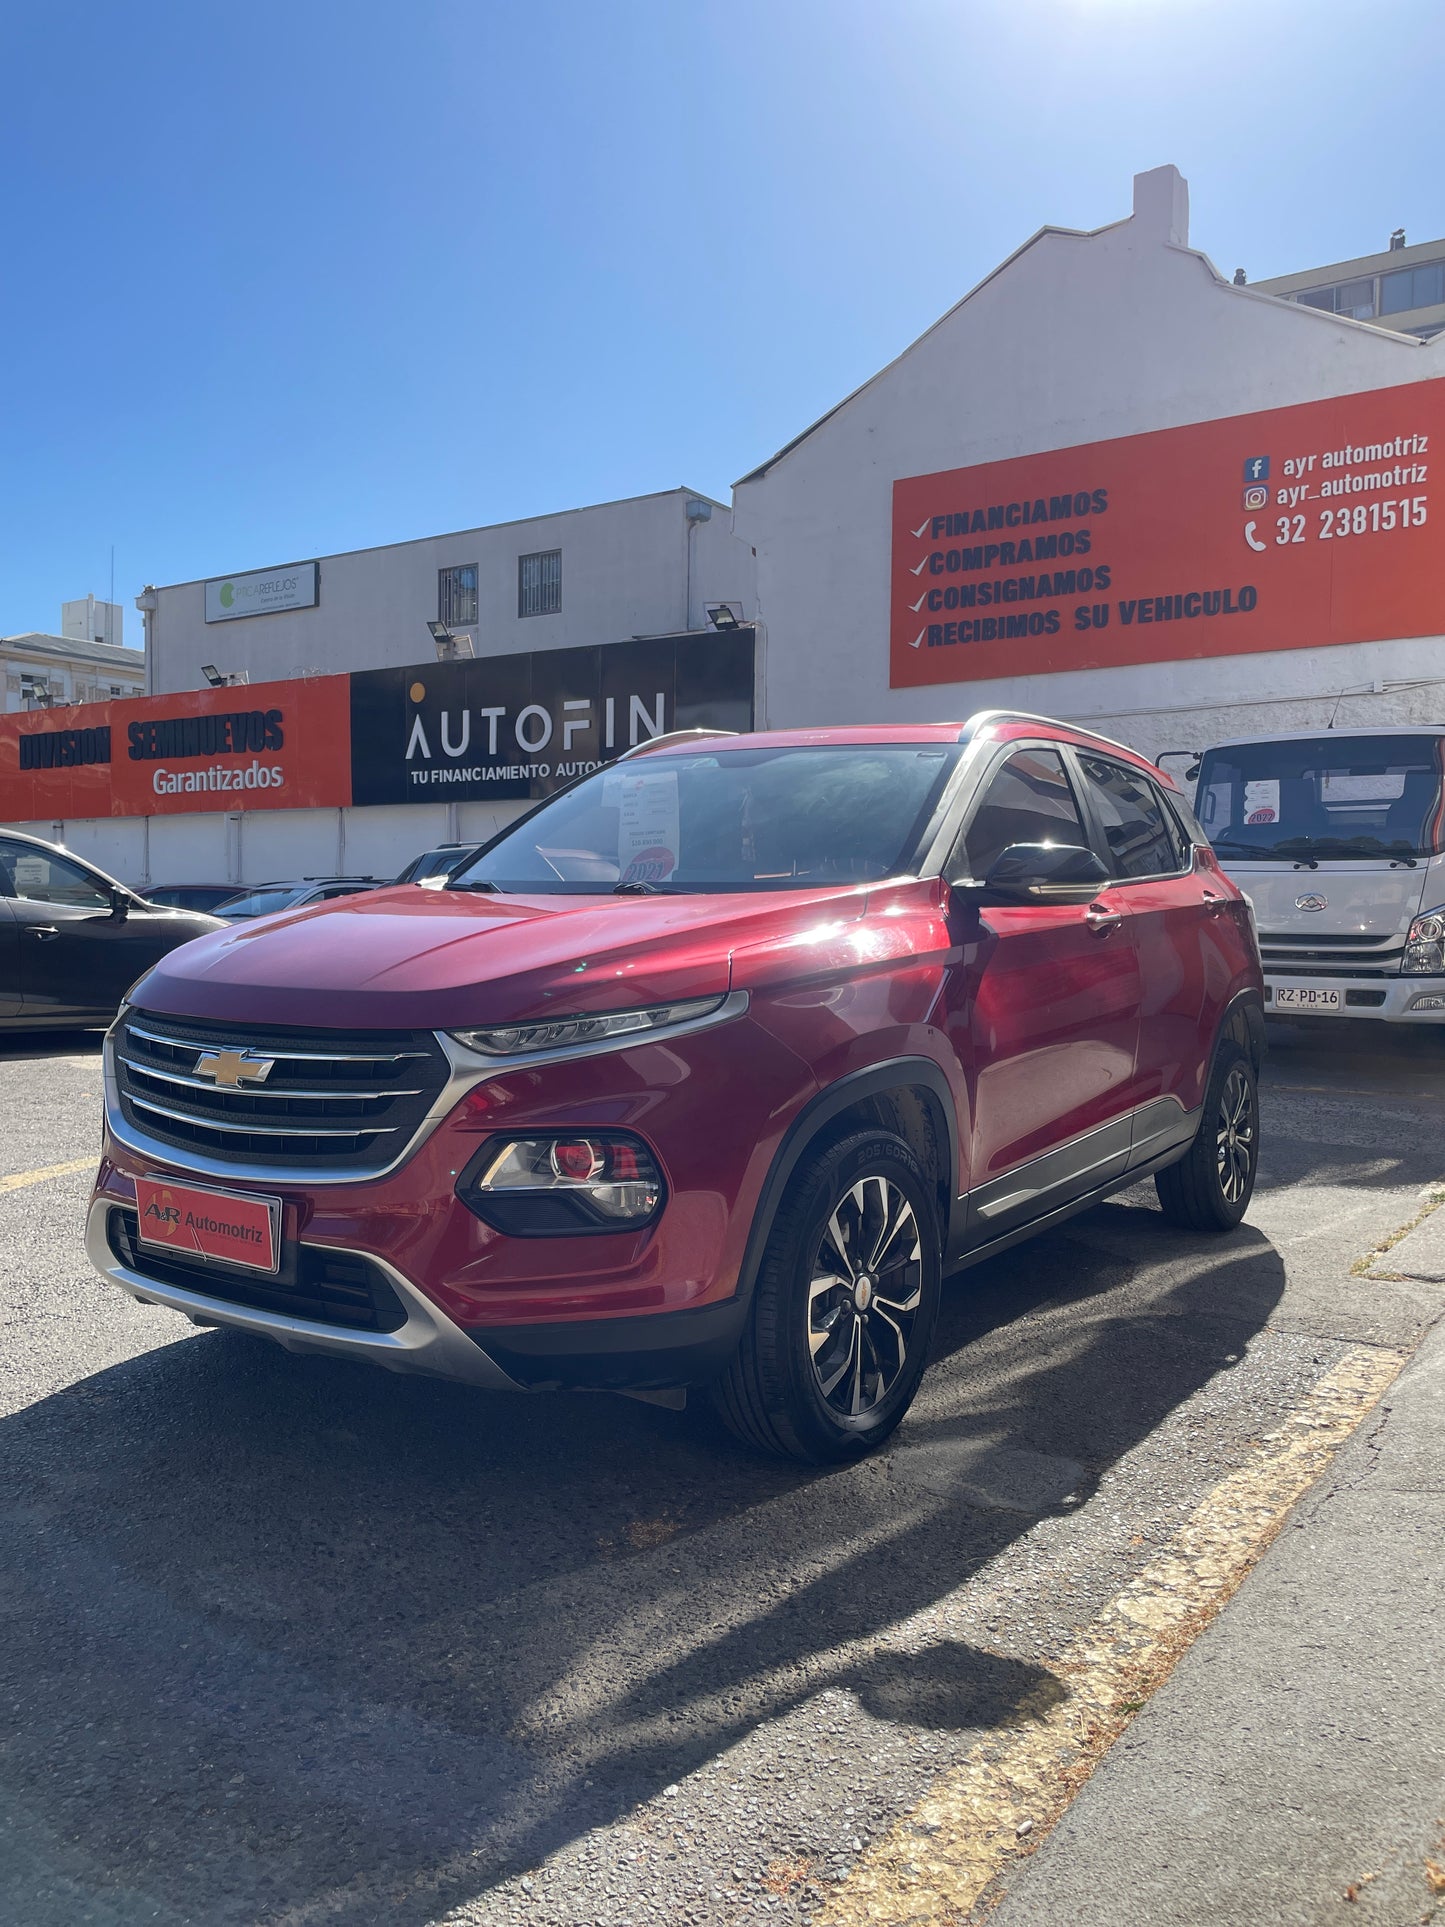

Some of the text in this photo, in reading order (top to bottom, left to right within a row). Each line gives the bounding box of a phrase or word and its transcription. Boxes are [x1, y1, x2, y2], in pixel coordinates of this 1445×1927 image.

[1283, 433, 1428, 479] ayr automotriz
[1276, 463, 1427, 508] ayr_automotriz
[931, 488, 1108, 539] FINANCIAMOS
[1275, 496, 1427, 545] 32 2381515
[929, 529, 1091, 575] COMPRAMOS
[927, 565, 1111, 612] CONSIGNAMOS
[927, 585, 1257, 647] RECIBIMOS SU VEHICULO
[19, 709, 283, 770] DIVISION SEMINUEVOS
[405, 691, 665, 760] AUTOFIN
[153, 760, 284, 795] Garantizados
[411, 771, 429, 784] TU
[431, 764, 550, 784] FINANCIAMIENTO
[1250, 813, 1273, 823] 2022
[627, 862, 665, 881] 2021
[185, 1212, 263, 1243] Automotriz
